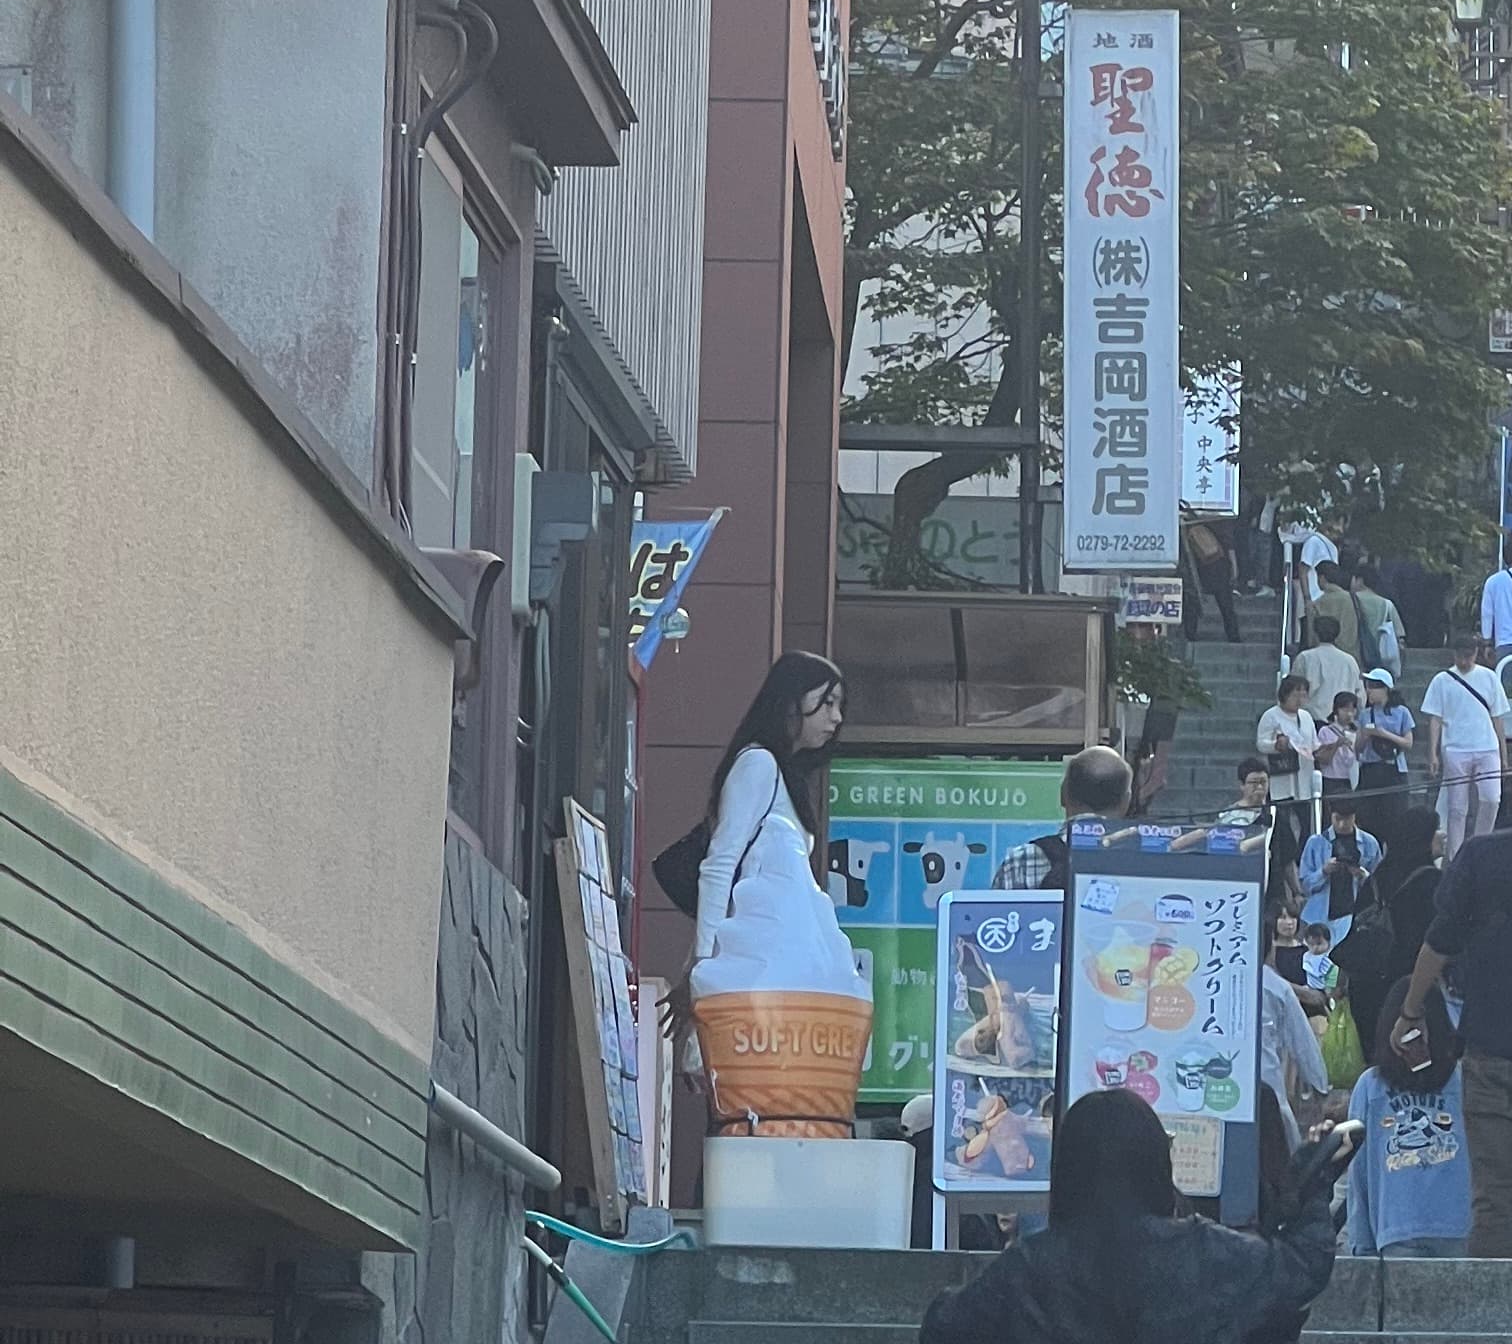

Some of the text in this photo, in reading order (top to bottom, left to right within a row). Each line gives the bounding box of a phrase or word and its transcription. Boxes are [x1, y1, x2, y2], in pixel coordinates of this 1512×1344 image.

[1092, 32, 1154, 49] 地酒
[1084, 62, 1166, 218] 聖徳
[1196, 434, 1213, 495] 中央亭
[1077, 535, 1166, 554] 0279-72-2292
[850, 785, 924, 805] GREEN
[1228, 890, 1249, 966] プレミアム
[1201, 898, 1225, 1036] ソフトクリーム
[734, 1023, 803, 1053] SOFT
